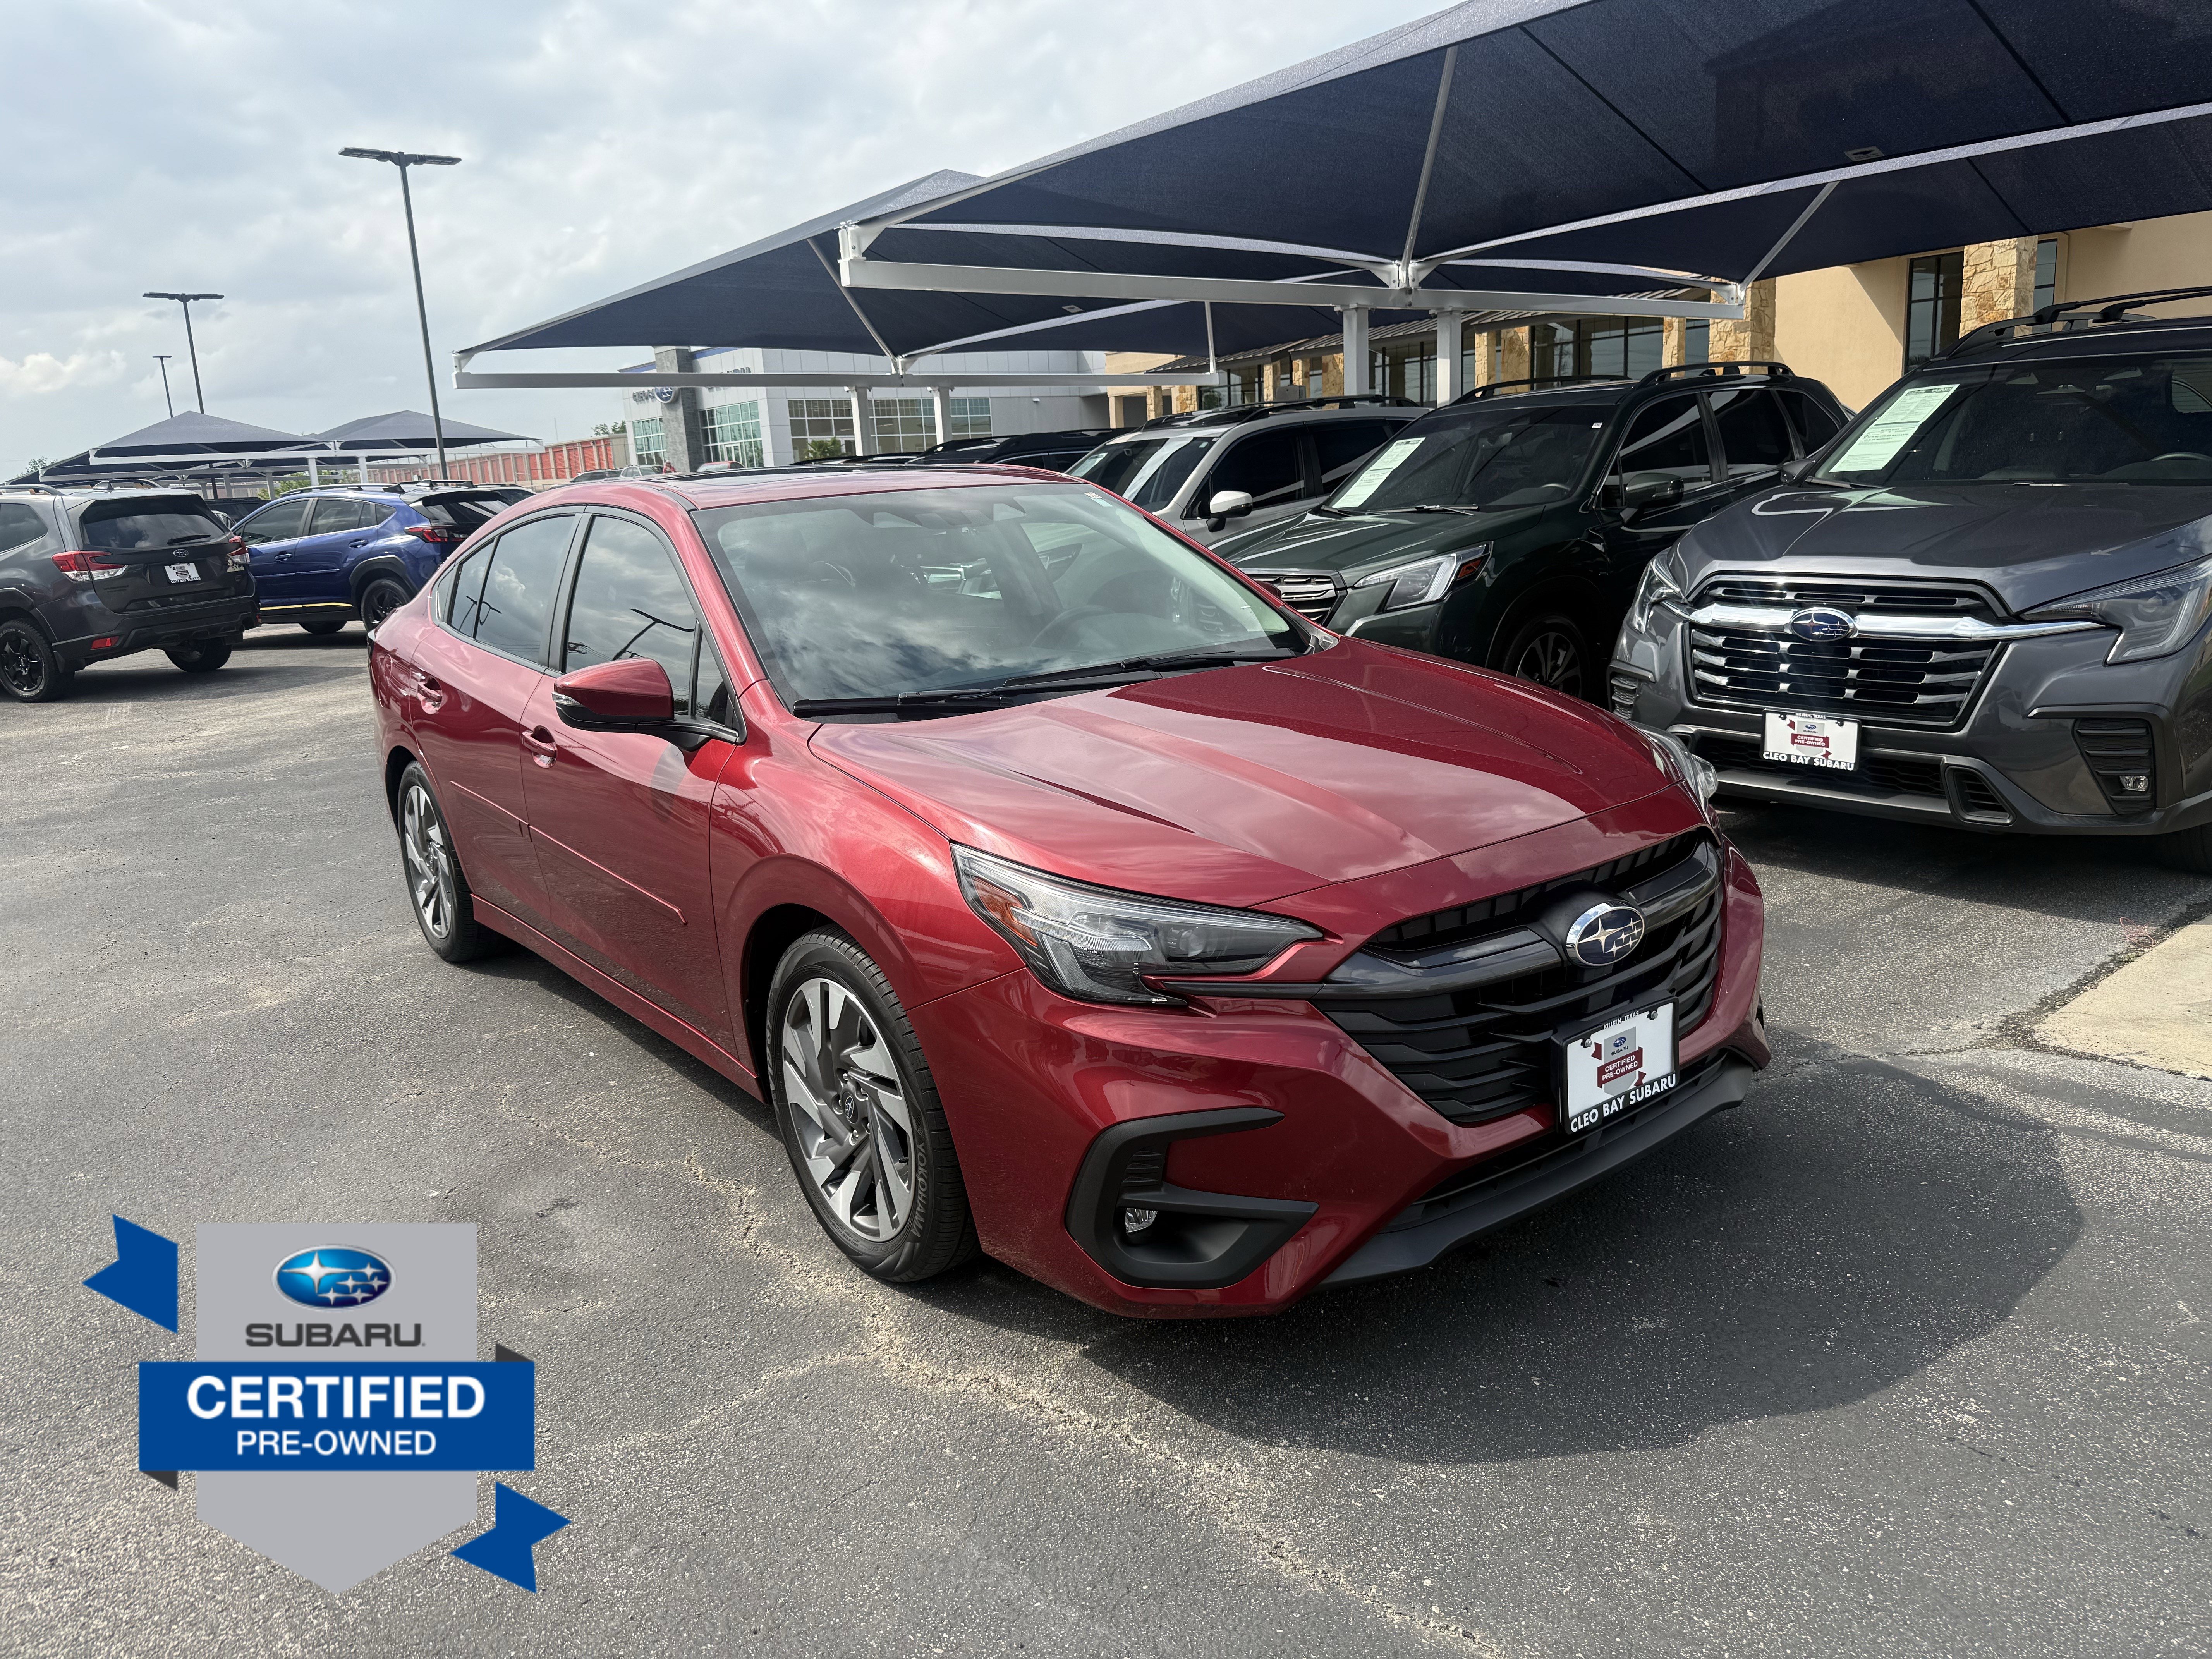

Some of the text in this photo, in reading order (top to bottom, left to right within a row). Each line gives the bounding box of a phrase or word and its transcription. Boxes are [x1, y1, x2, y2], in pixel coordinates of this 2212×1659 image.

[1763, 752, 1854, 771] CLEO BAY SUBARU
[1624, 1010, 1639, 1021] TEXAS
[1611, 1046, 1628, 1056] SUBARU
[1602, 1061, 1638, 1081] PRE-OWNED
[1605, 1055, 1635, 1072] CERTIFIED
[1571, 1073, 1676, 1132] CLEO BAY SUBARU
[912, 1142, 927, 1237] YOKOHAMA
